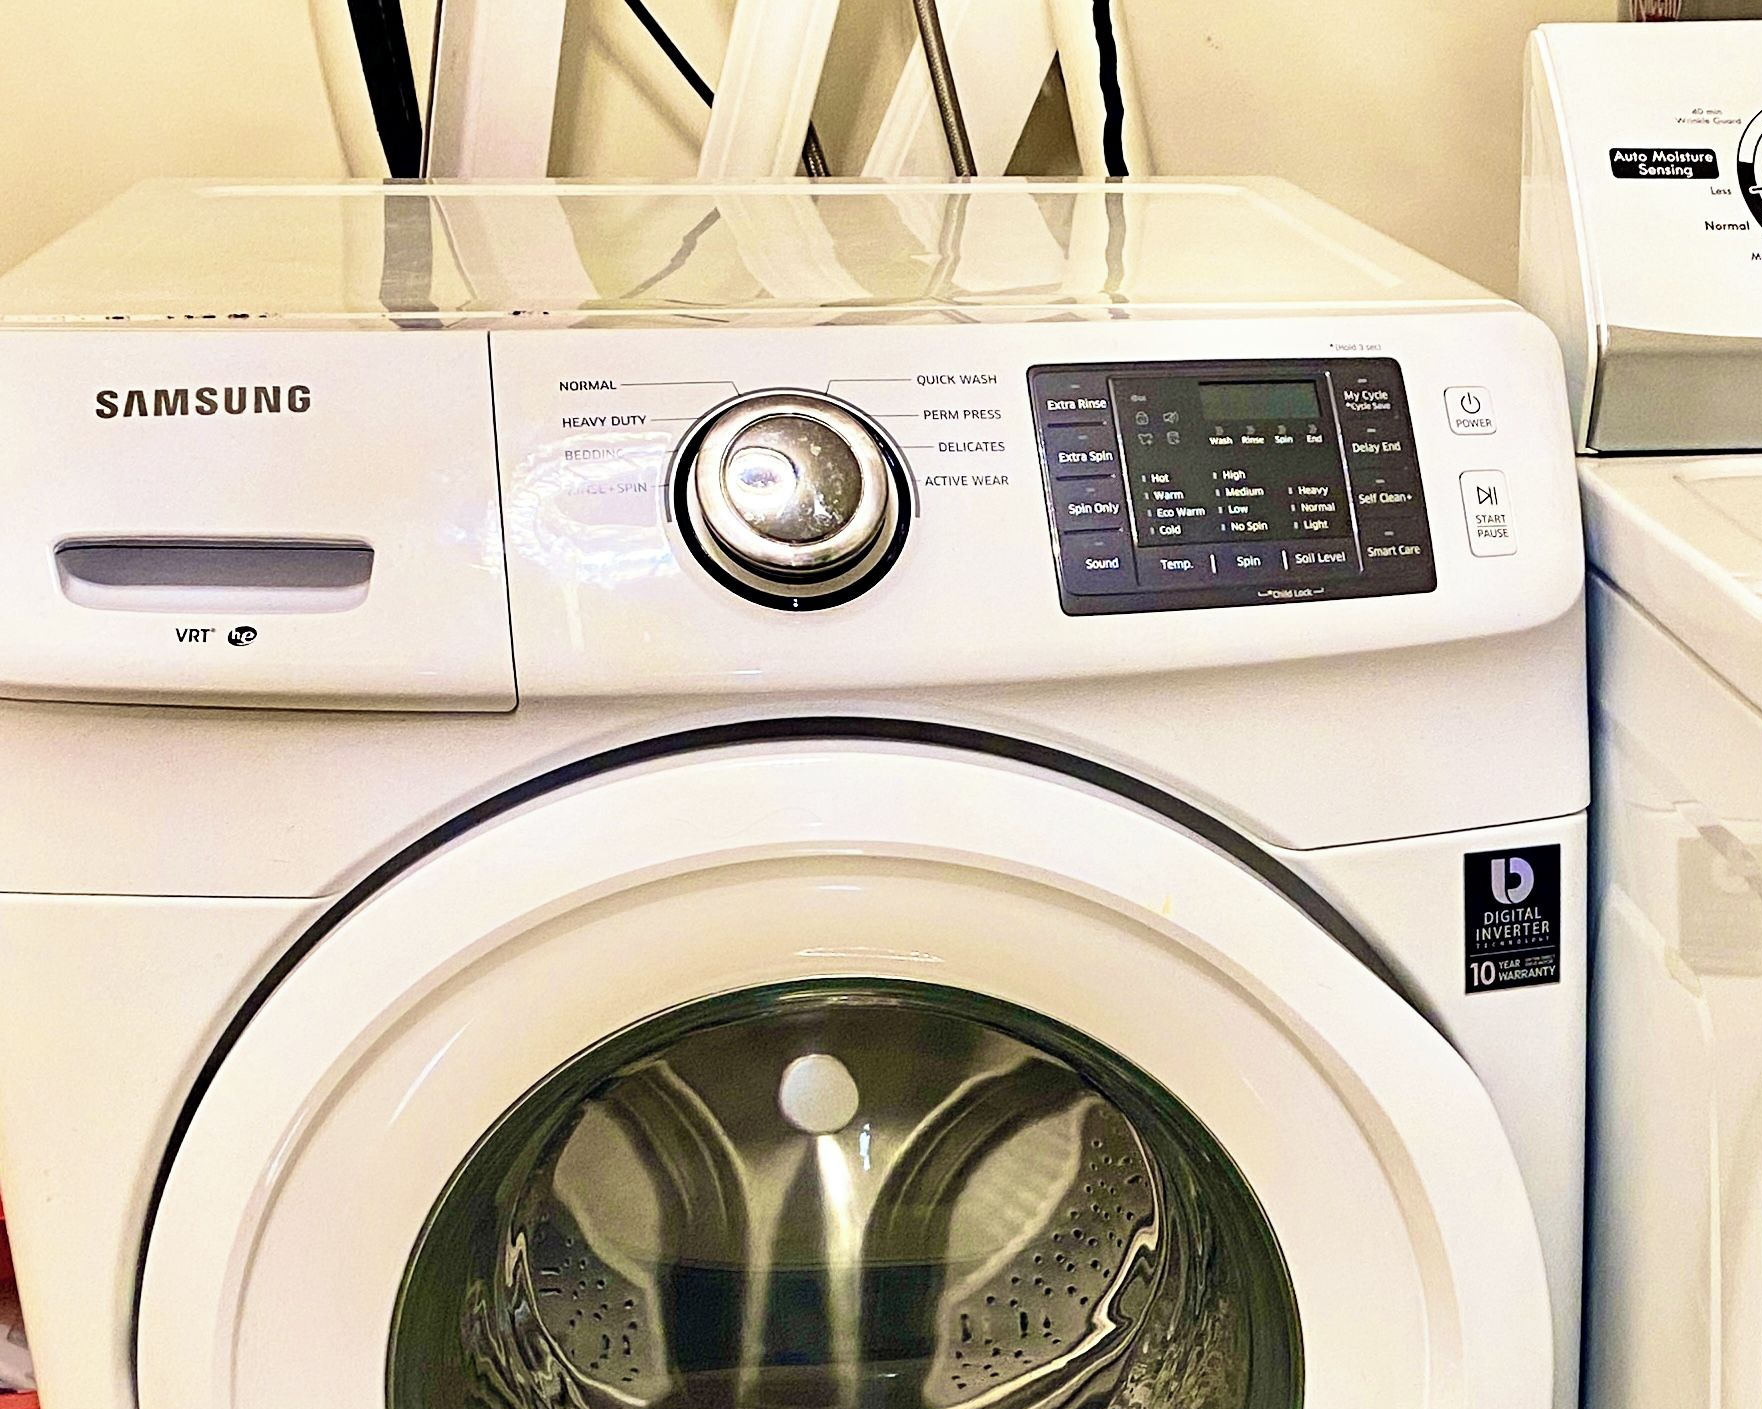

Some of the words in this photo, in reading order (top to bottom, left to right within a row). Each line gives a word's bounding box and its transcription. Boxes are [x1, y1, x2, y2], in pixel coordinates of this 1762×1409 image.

[1712, 117, 1742, 125] Guard
[1613, 151, 1648, 163] Auto
[1652, 151, 1714, 163] Moisture
[1638, 164, 1694, 179] Sensing
[1710, 186, 1732, 196] Less
[1704, 221, 1750, 231] Normal
[559, 380, 617, 392] NORMAL
[916, 375, 956, 387] QUICK
[959, 375, 997, 385] WASH
[1344, 391, 1360, 402] My
[1362, 390, 1389, 402] Cycle
[96, 385, 311, 419] SAMSUNG
[1047, 400, 1075, 411] Extra
[1078, 398, 1107, 410] Rinse
[923, 410, 959, 420] PERM
[963, 410, 1002, 420] PRESS
[562, 417, 607, 428] HEAVY
[611, 415, 647, 427] DUTY
[1456, 418, 1493, 428] POWER
[1209, 436, 1234, 445] Wash
[1241, 435, 1265, 445] Rinse
[1274, 435, 1294, 444] Spin
[1306, 434, 1323, 443] End
[938, 442, 1006, 452] DELICATES
[1352, 443, 1380, 454] Delay
[1382, 441, 1402, 452] End
[1058, 451, 1088, 463] Extra
[1089, 450, 1114, 463] Spin
[925, 476, 968, 486] ACTIVE
[972, 475, 1010, 486] WEAR
[1151, 473, 1170, 483] Hot
[1222, 470, 1247, 481] High
[1153, 490, 1185, 500] Warm
[1225, 487, 1265, 497] Medium
[1298, 486, 1329, 497] Heavy
[1358, 493, 1377, 505] Self
[1379, 492, 1413, 503] Clean+
[1068, 503, 1092, 516] Spin
[1094, 502, 1120, 515] Only
[1156, 509, 1175, 518] Eco
[1176, 507, 1206, 517] Warm
[1228, 505, 1249, 514] Low
[1301, 502, 1336, 512] Normal
[1475, 514, 1507, 524] START
[1159, 524, 1182, 535] Cold
[1231, 522, 1246, 531] No
[1246, 521, 1269, 532] Spin
[1303, 519, 1330, 531] Light
[1477, 528, 1509, 539] PAUSE
[1368, 546, 1396, 558] Smart
[1399, 544, 1422, 555] Care
[1236, 556, 1262, 568] Spin
[1295, 552, 1315, 564] Soil
[1318, 551, 1347, 563] Level
[1085, 557, 1120, 570] Sound
[1160, 559, 1195, 571] Temp.
[175, 628, 211, 643] VRT
[1484, 907, 1542, 925] DIGITAL
[1476, 921, 1550, 942] INVERTER
[1470, 961, 1496, 986] 10
[1498, 959, 1521, 970] YEAR
[1498, 965, 1556, 982] WARRANTY
